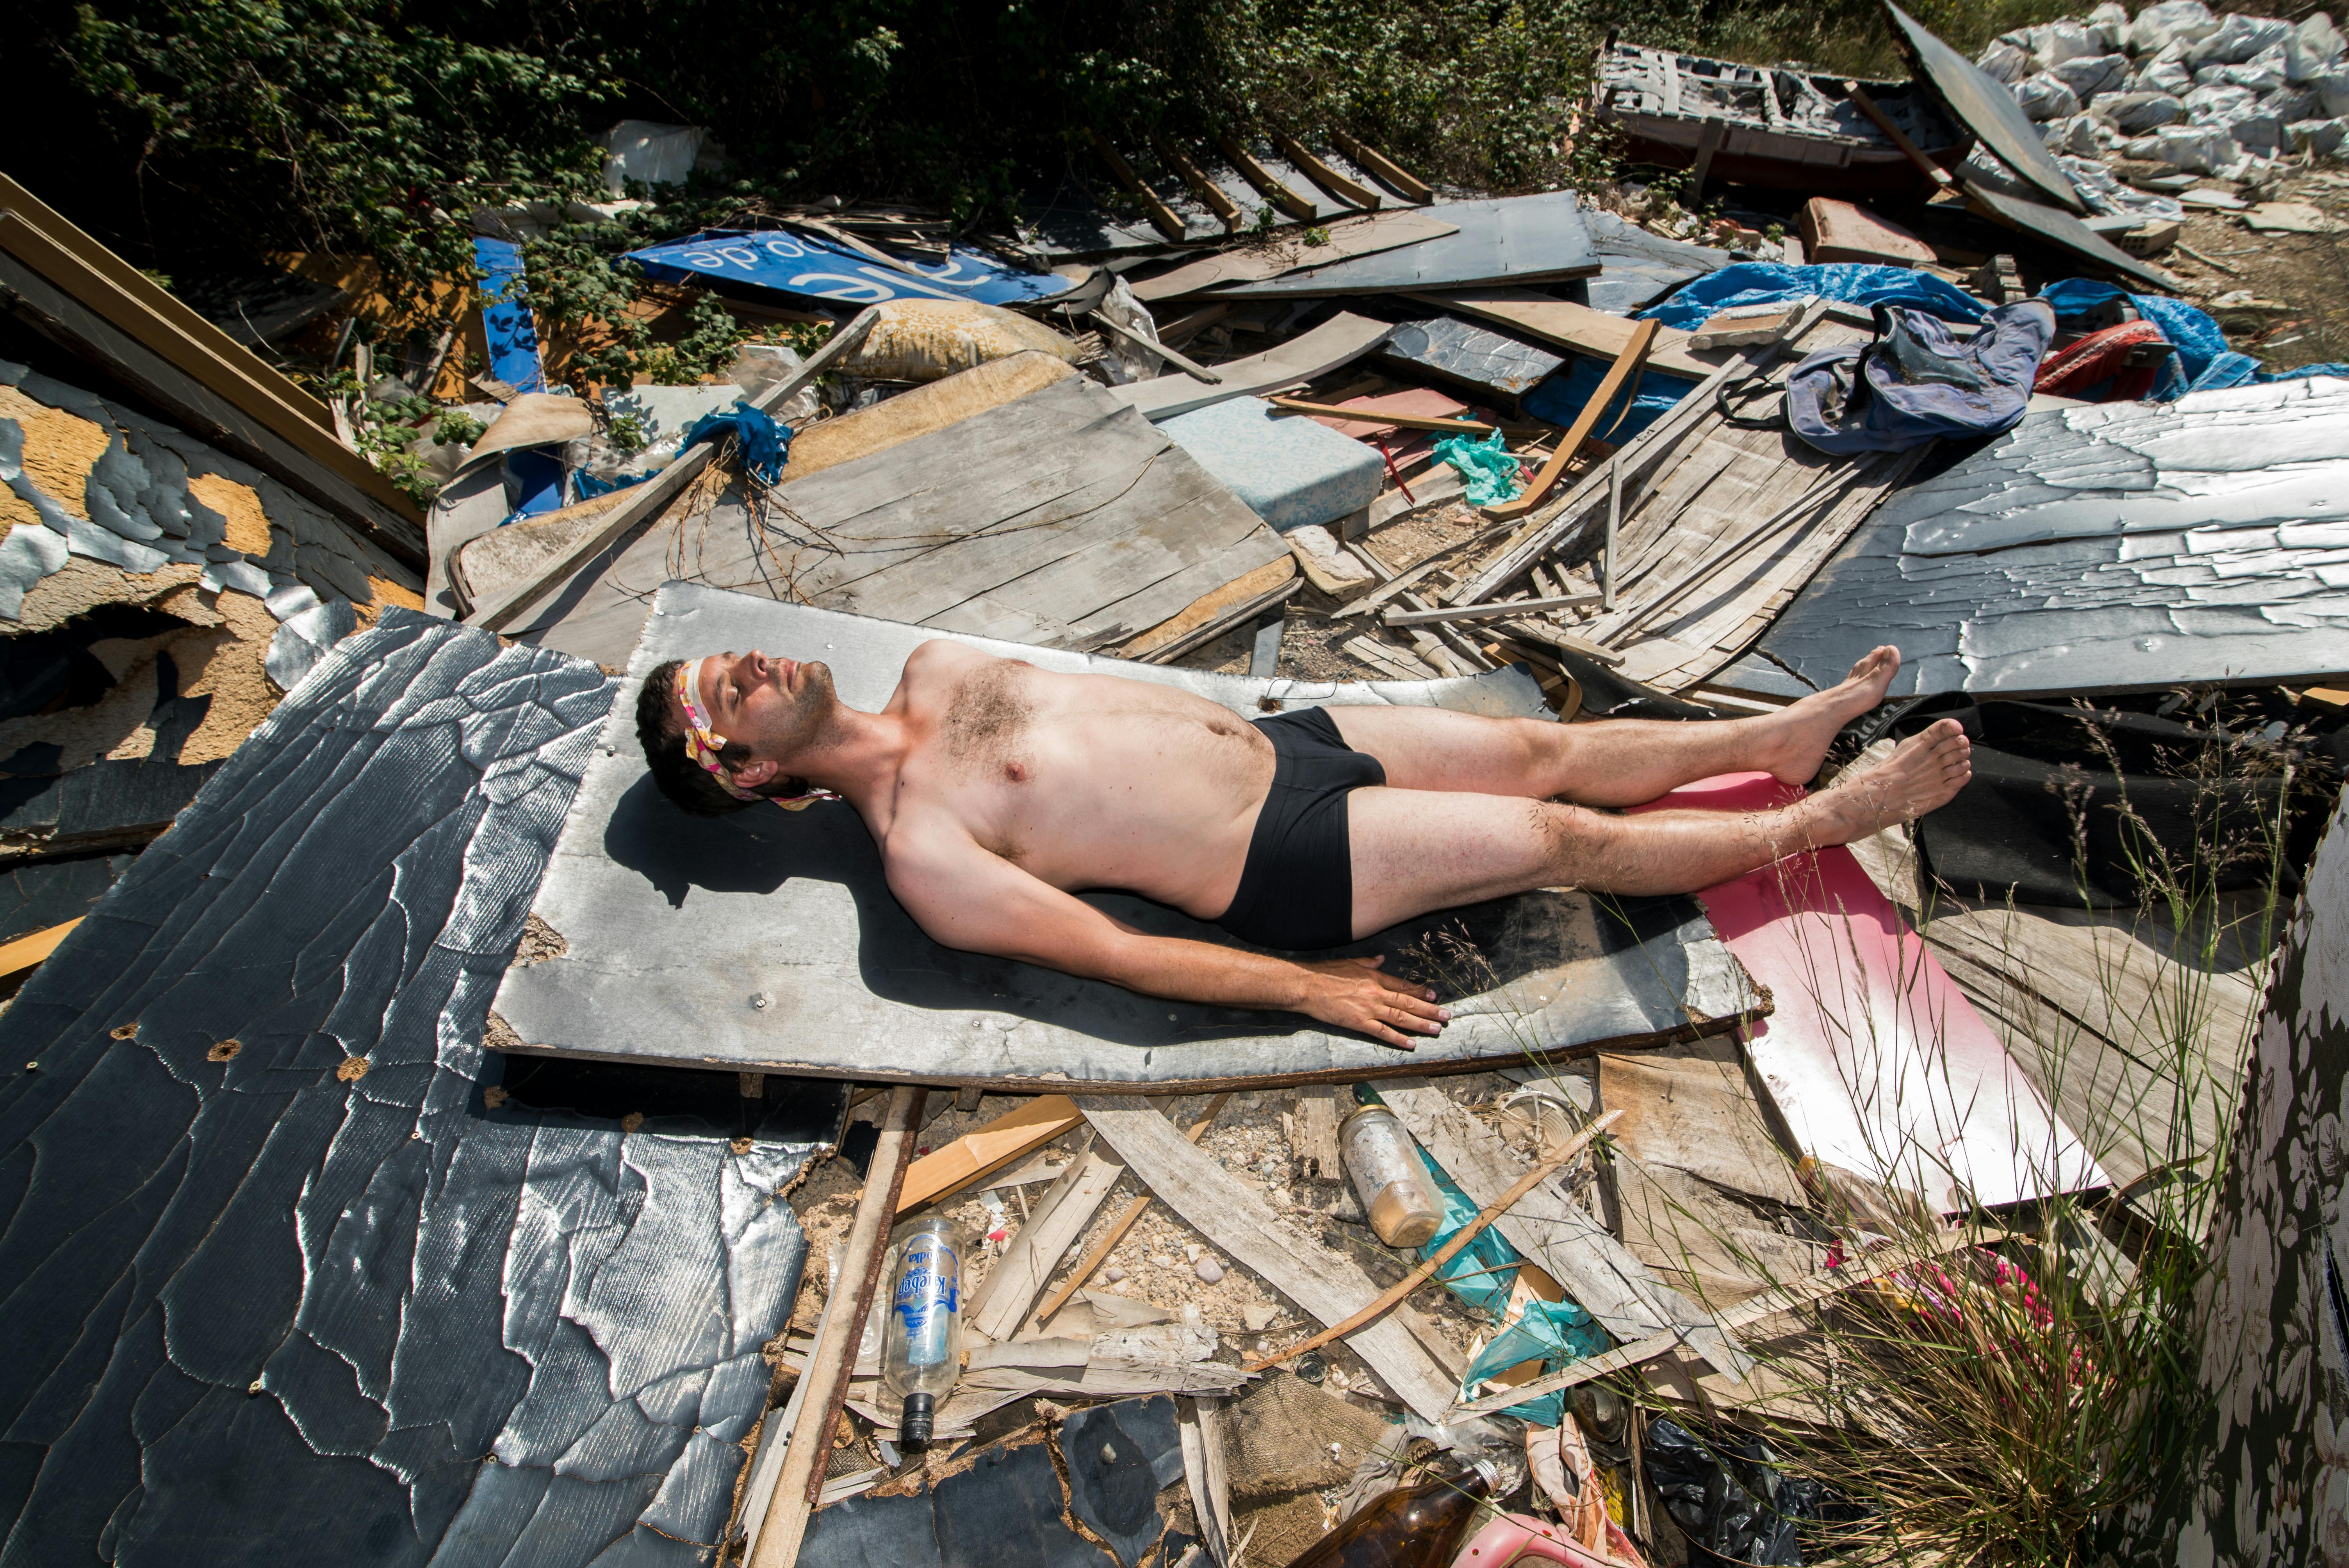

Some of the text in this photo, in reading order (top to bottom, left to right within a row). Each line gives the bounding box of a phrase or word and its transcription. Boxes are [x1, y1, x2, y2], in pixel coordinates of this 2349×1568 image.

[683, 233, 847, 271] po de
[908, 1251, 940, 1264] Vodka
